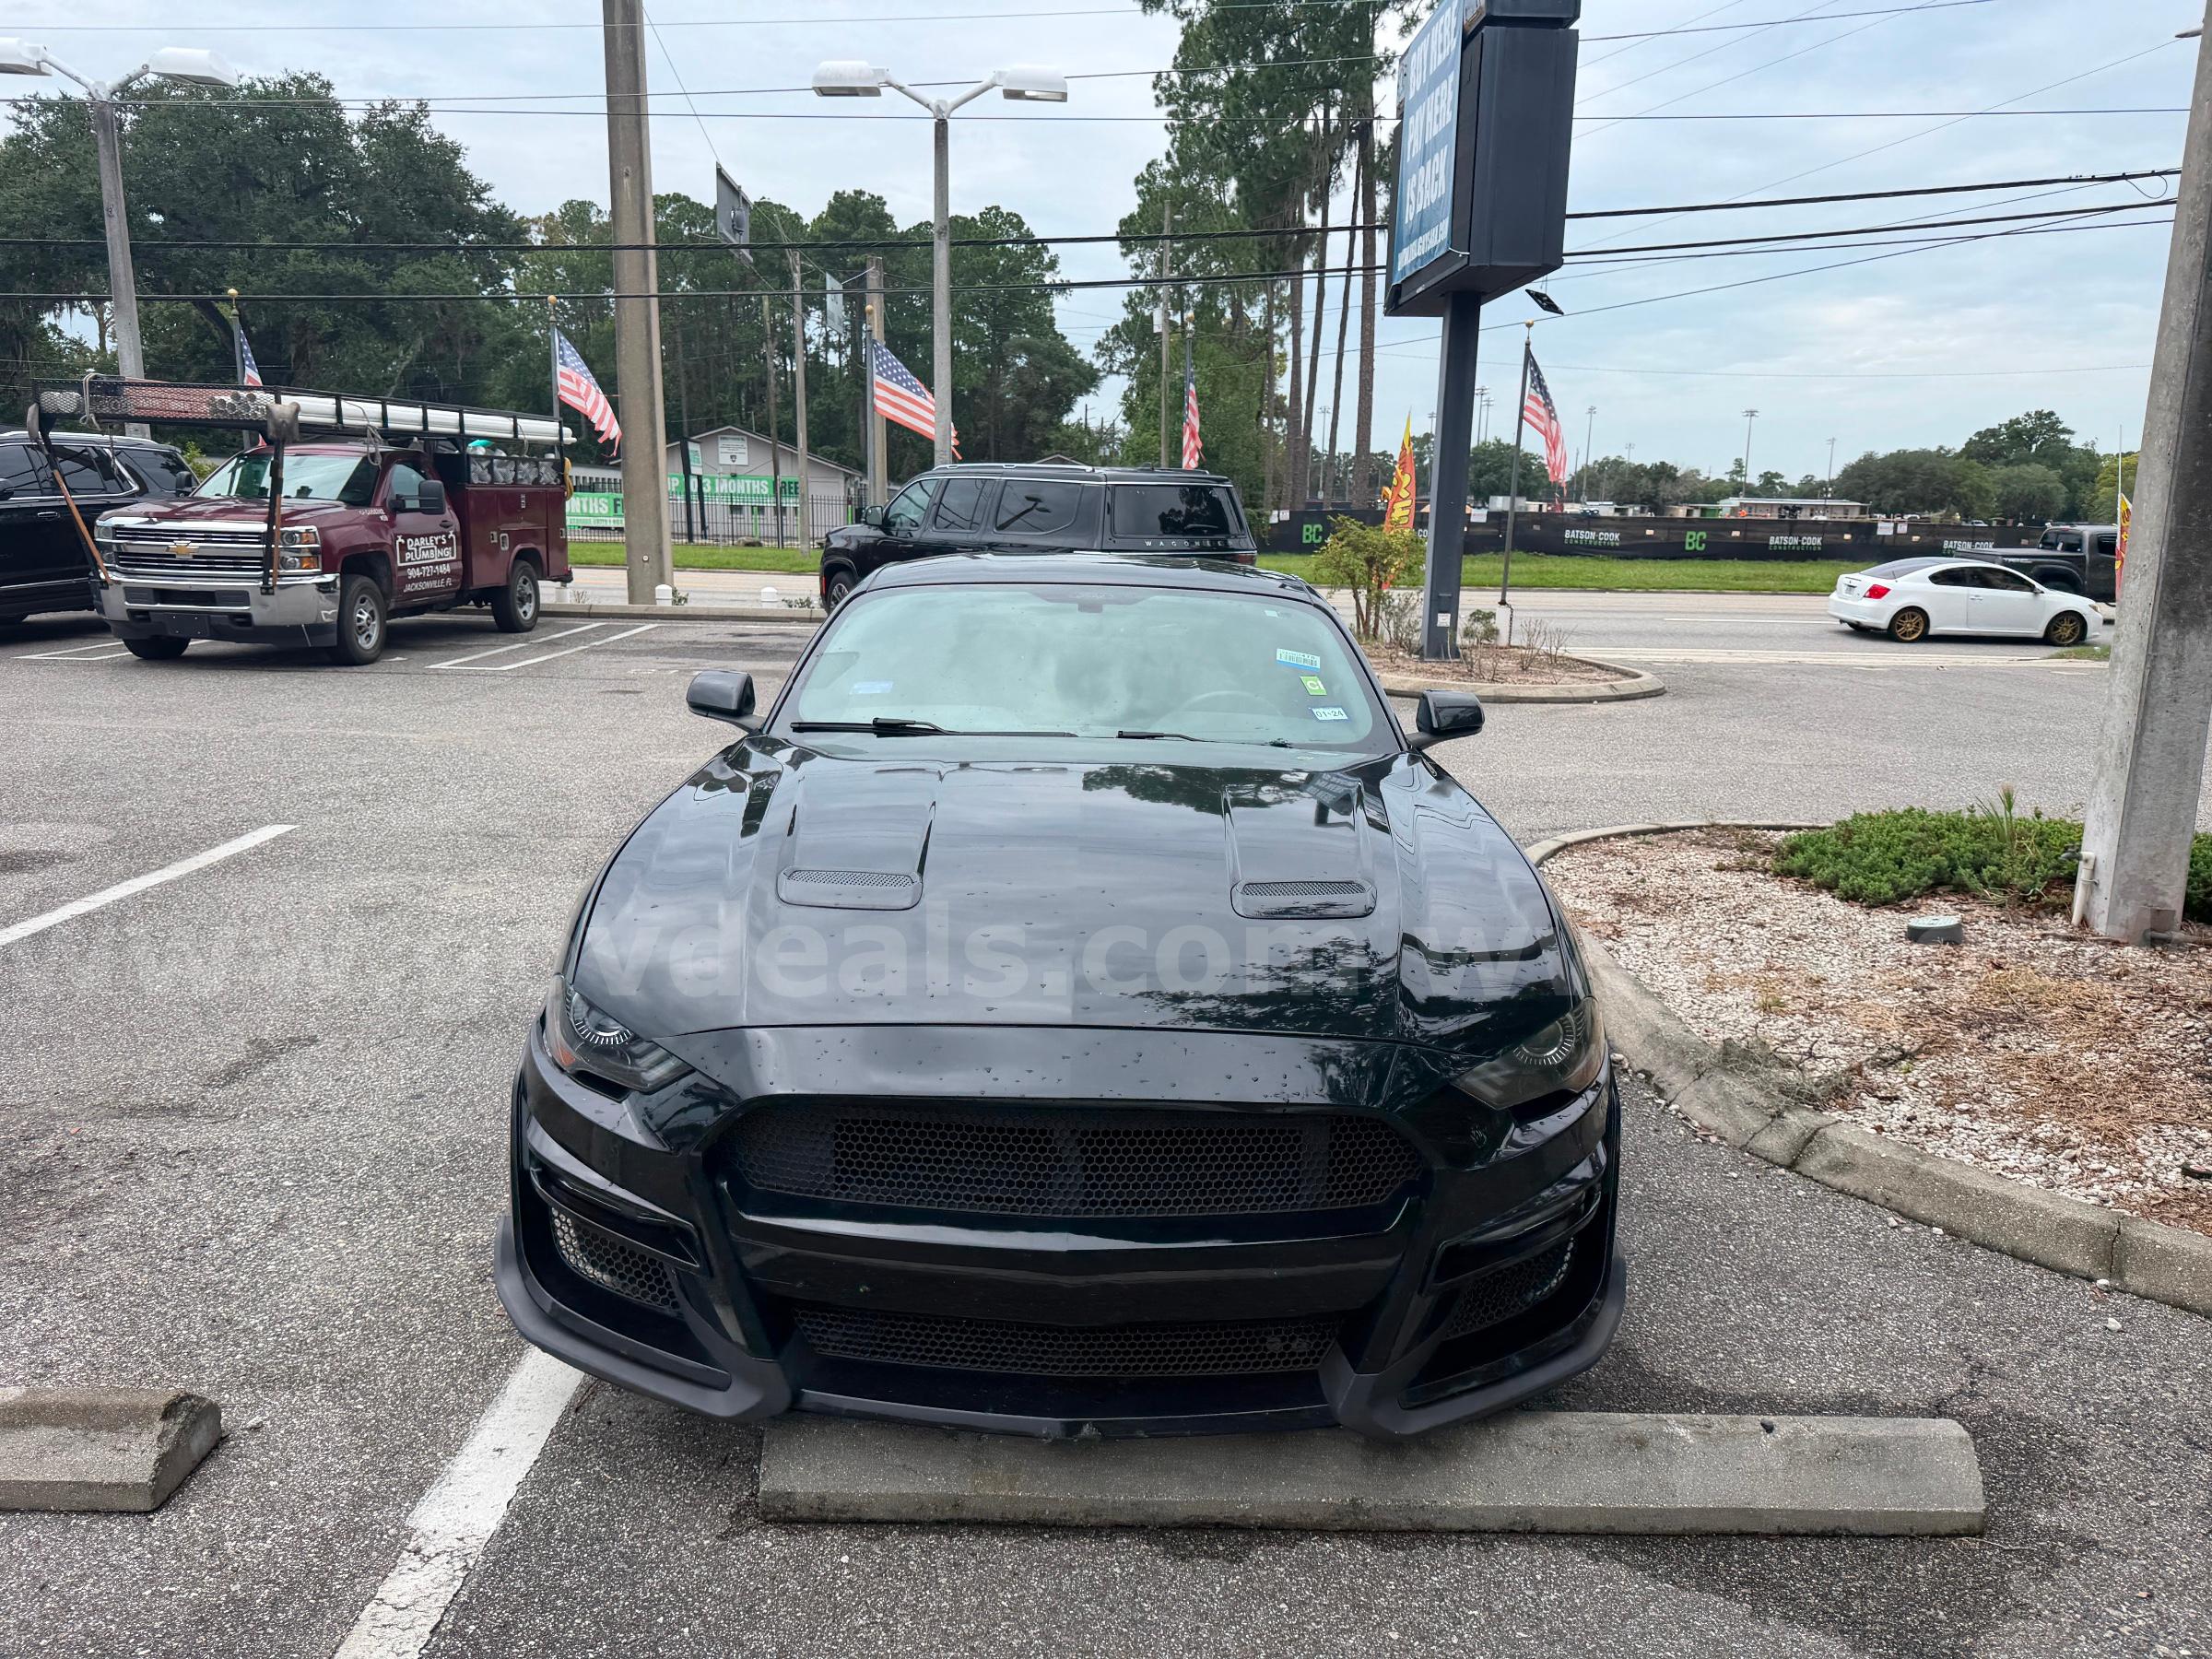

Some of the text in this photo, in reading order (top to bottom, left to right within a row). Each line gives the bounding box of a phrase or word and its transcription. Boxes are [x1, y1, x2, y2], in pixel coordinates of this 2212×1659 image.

[1409, 0, 1458, 100] BUY HERE
[1406, 71, 1454, 163] PAY HERE
[1405, 145, 1448, 224] IS BACK
[702, 478, 711, 493] 3
[715, 478, 769, 494] MONTHS
[407, 535, 447, 547] DARLEY'S
[1302, 524, 1324, 544] BC
[1564, 529, 1620, 542] BATSON-COOK
[1684, 530, 1708, 551] BC
[1769, 535, 1822, 547] BATSON-COOK
[1564, 538, 1620, 547] CONSTRUCTION
[1942, 539, 1994, 550] BATSON-COOK
[406, 546, 450, 562] PLUMBING
[406, 563, 451, 579] 904-727-1484
